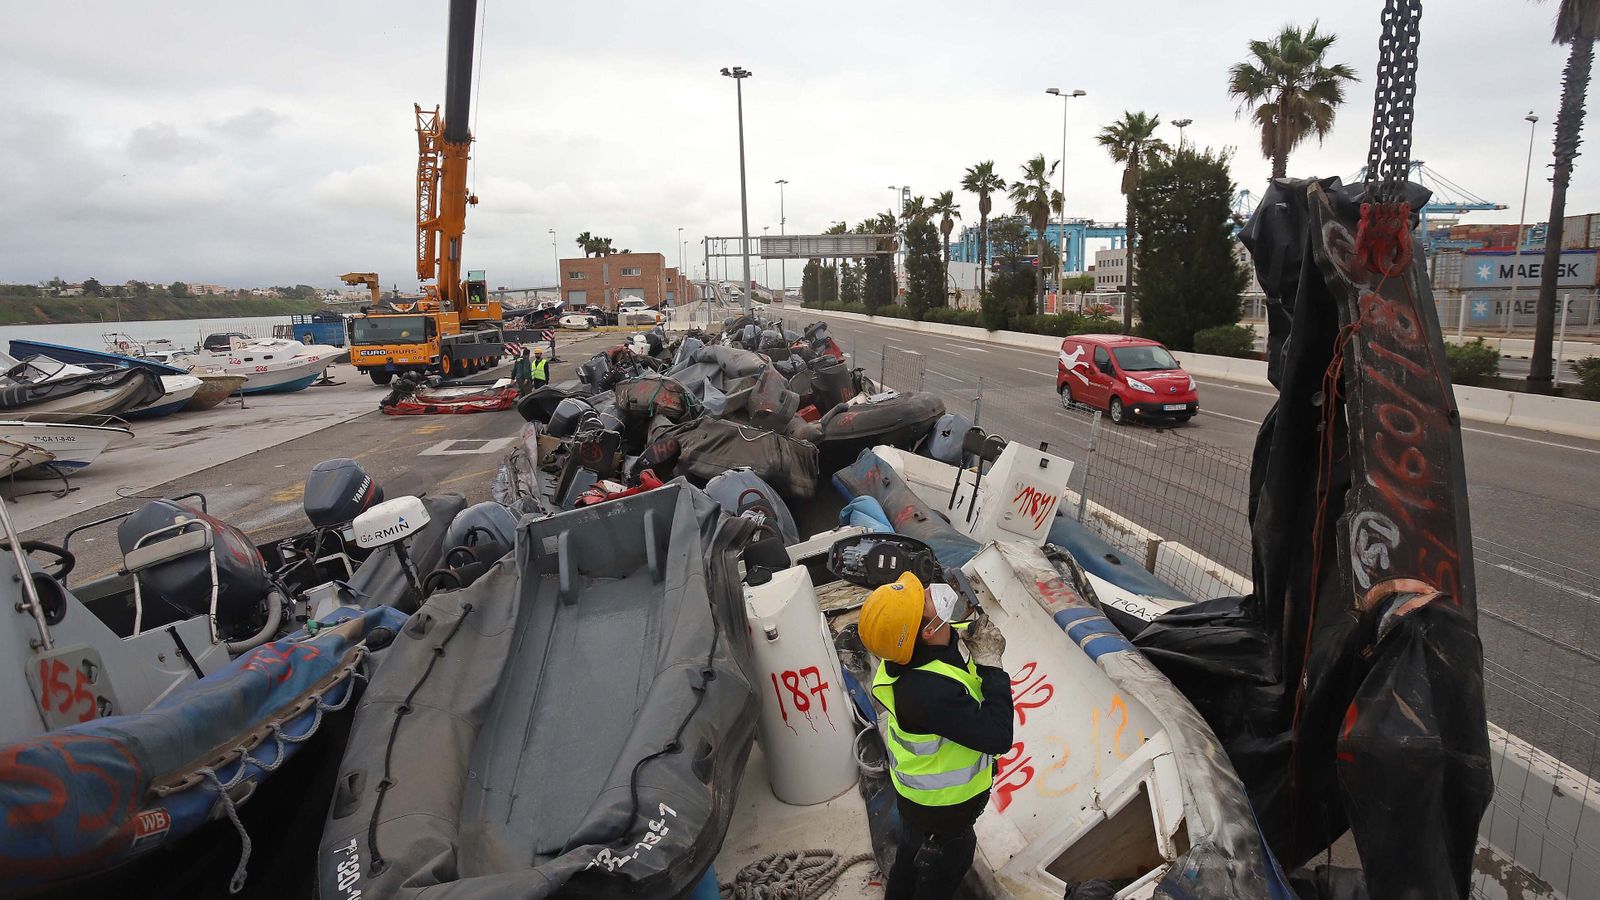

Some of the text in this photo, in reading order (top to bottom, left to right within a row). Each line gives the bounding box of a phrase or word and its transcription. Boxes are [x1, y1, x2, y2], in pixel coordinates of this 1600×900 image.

[1500, 263, 1579, 279] MAESK
[352, 474, 371, 503] YAMAHA
[360, 522, 410, 543] GARMIN
[40, 658, 97, 723] 155
[771, 666, 830, 723] 187
[140, 812, 166, 832] WB
